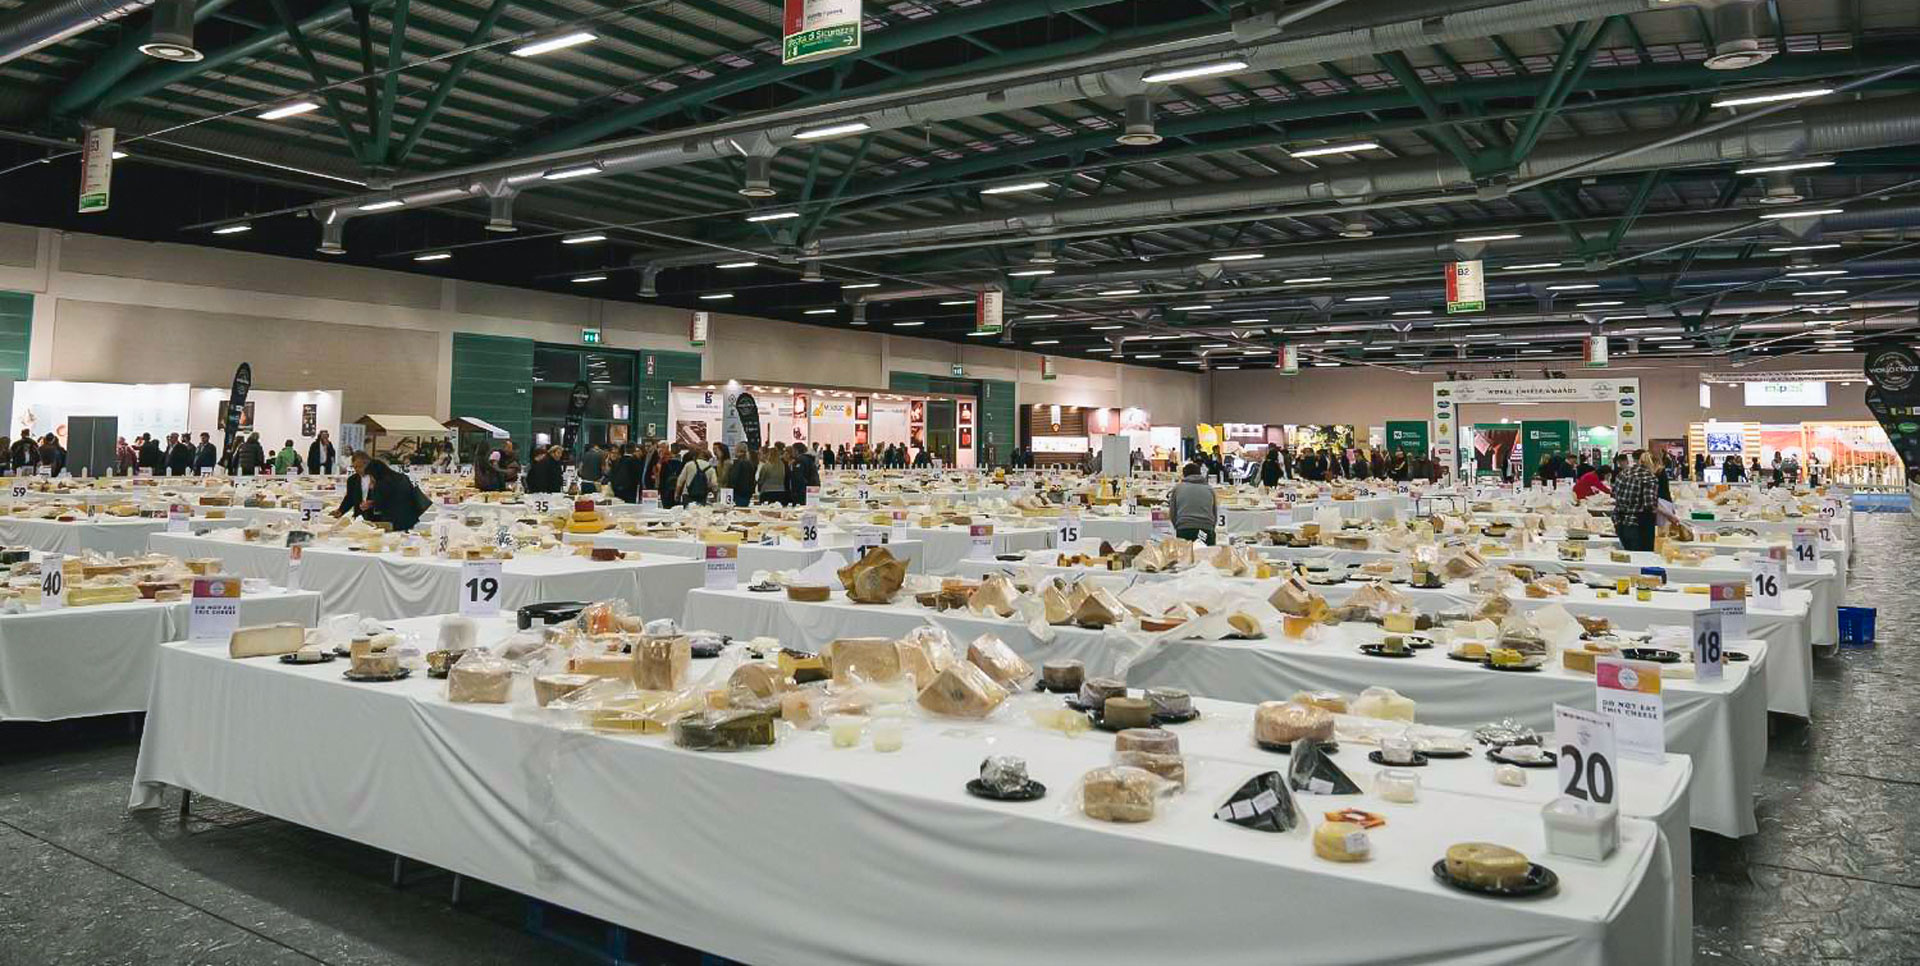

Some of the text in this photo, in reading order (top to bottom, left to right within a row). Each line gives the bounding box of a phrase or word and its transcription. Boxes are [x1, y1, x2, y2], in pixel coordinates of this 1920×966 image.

[13, 487, 26, 497] 59
[1284, 494, 1296, 502] 30
[535, 501, 548, 512] 35
[803, 526, 817, 540] 36
[1060, 527, 1077, 541] 15
[1796, 544, 1814, 561] 14
[43, 570, 61, 596] 40
[466, 578, 498, 602] 19
[1756, 574, 1778, 596] 16
[1698, 631, 1720, 664] 18
[1602, 706, 1658, 720] THIS CHEESE
[1561, 744, 1613, 804] 20
